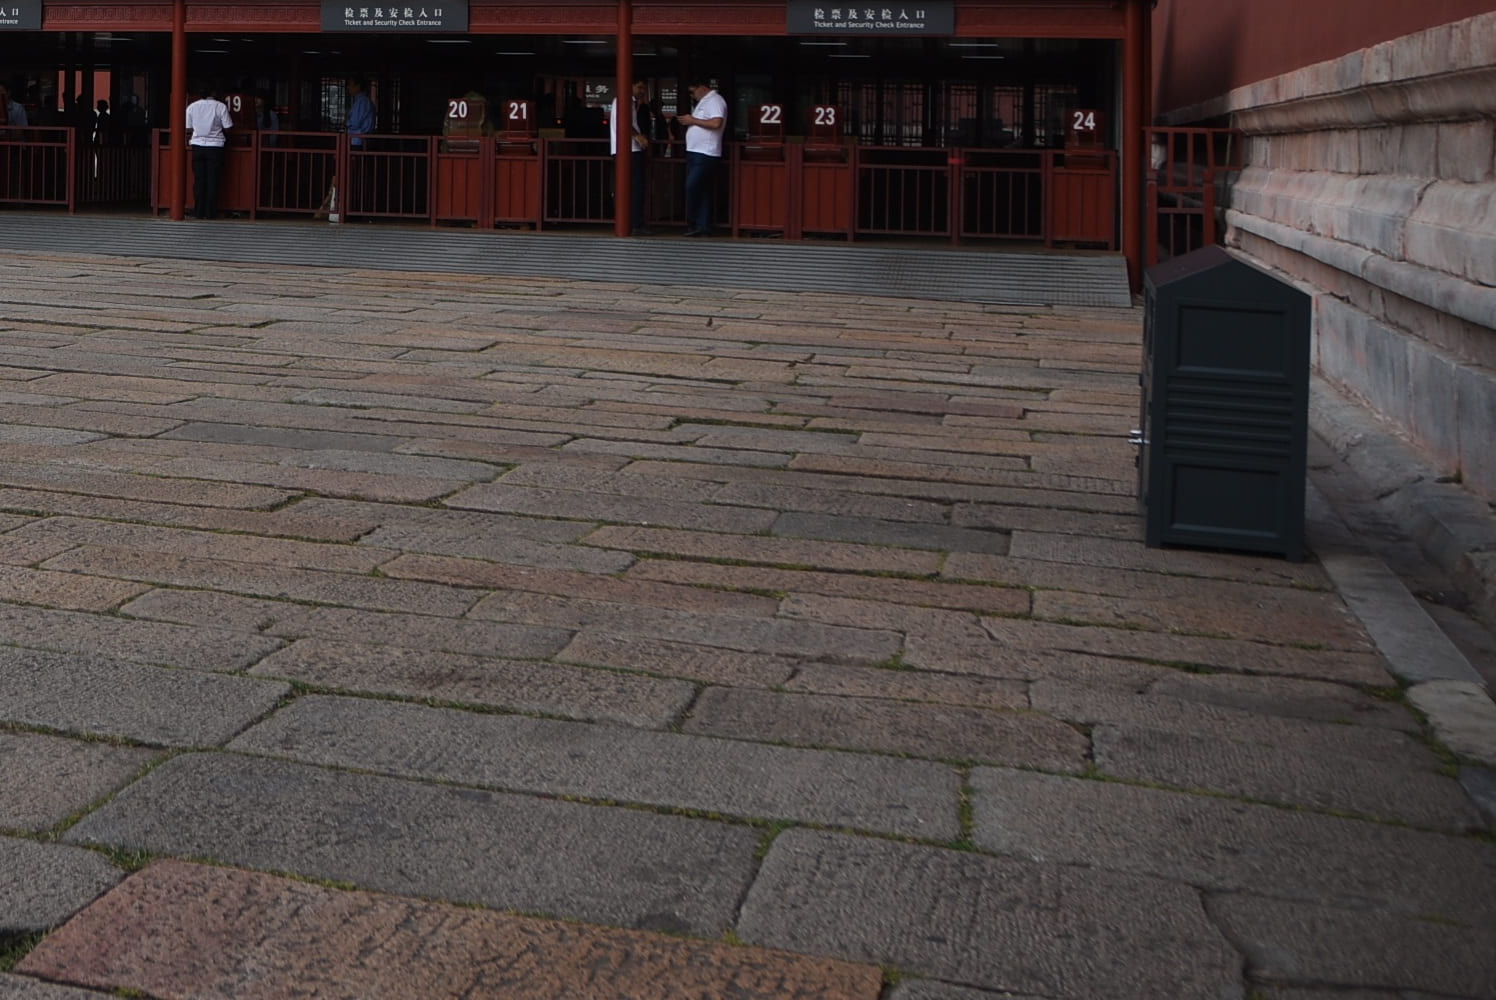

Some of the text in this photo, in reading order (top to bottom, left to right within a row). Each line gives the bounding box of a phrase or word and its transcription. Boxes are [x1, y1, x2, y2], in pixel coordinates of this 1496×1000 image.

[344, 7, 442, 18] 检票及安检入口
[813, 8, 926, 20] 检票及安检入口
[813, 20, 925, 29] Ticket and Security Check Entrance
[225, 95, 241, 112] 19
[448, 100, 468, 118] 20
[509, 102, 527, 120] 21
[760, 105, 782, 124] 22
[814, 107, 836, 126] 23
[1073, 111, 1096, 131] 24
